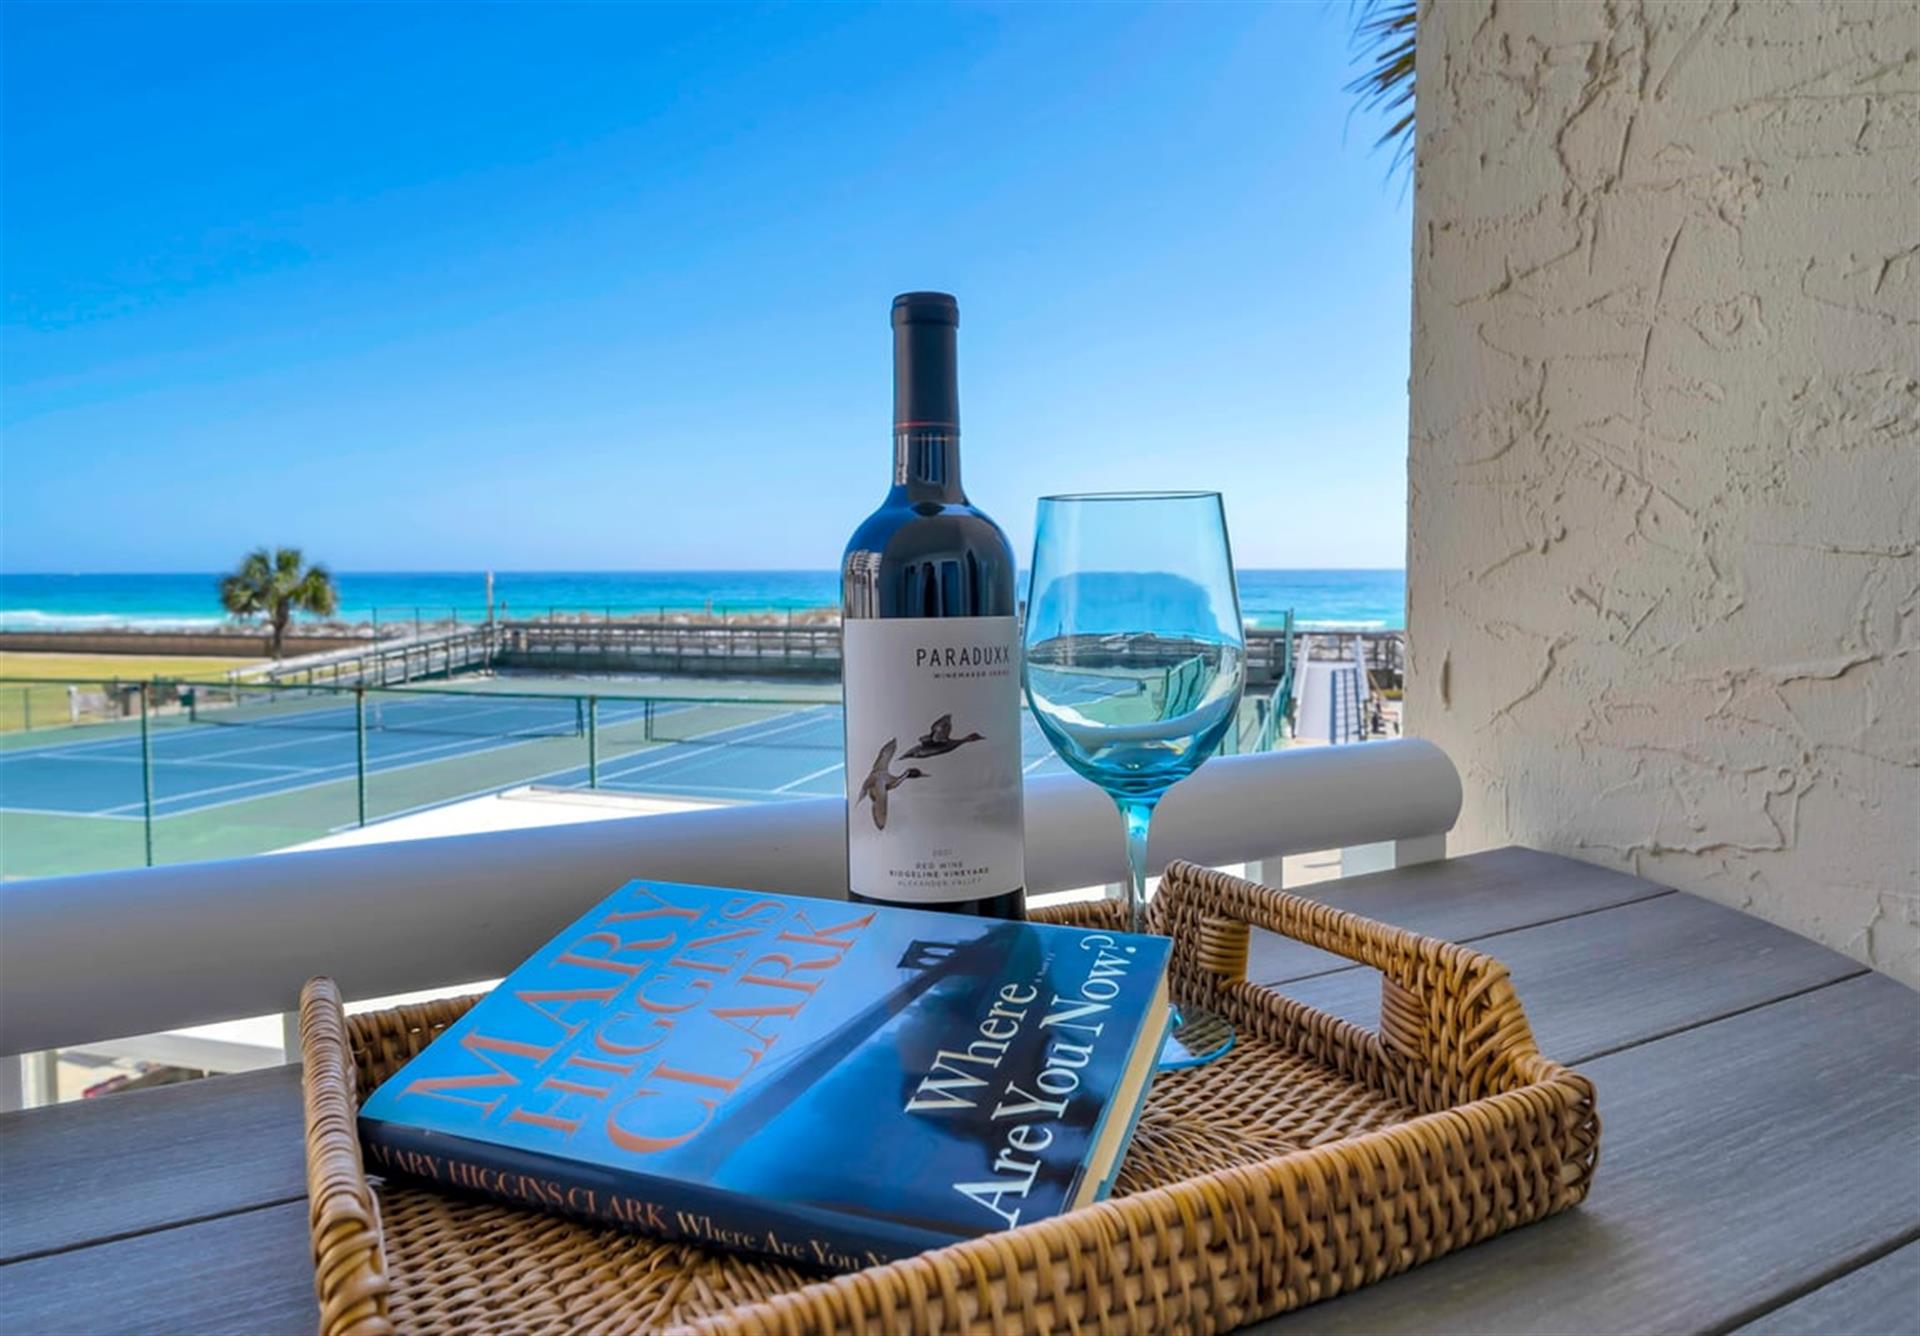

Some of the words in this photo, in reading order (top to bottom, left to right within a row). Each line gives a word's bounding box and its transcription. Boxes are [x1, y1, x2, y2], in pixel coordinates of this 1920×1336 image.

[915, 645, 1010, 667] PARADUXX
[916, 861, 936, 870] RED
[939, 860, 963, 869] WINE
[395, 884, 706, 1121] MARY
[504, 896, 789, 1142] HIGGINS
[606, 908, 878, 1154] CLARK
[1038, 933, 1138, 1038] Now?
[903, 982, 1038, 1115] Where
[990, 1042, 1094, 1121] You
[370, 1143, 443, 1179] MARY
[447, 1158, 565, 1207] HIGGINS
[566, 1184, 669, 1233] CLARK
[675, 1210, 757, 1249] Where
[763, 1230, 806, 1260] Are
[809, 1238, 860, 1272] You
[952, 1123, 1054, 1230] Are
